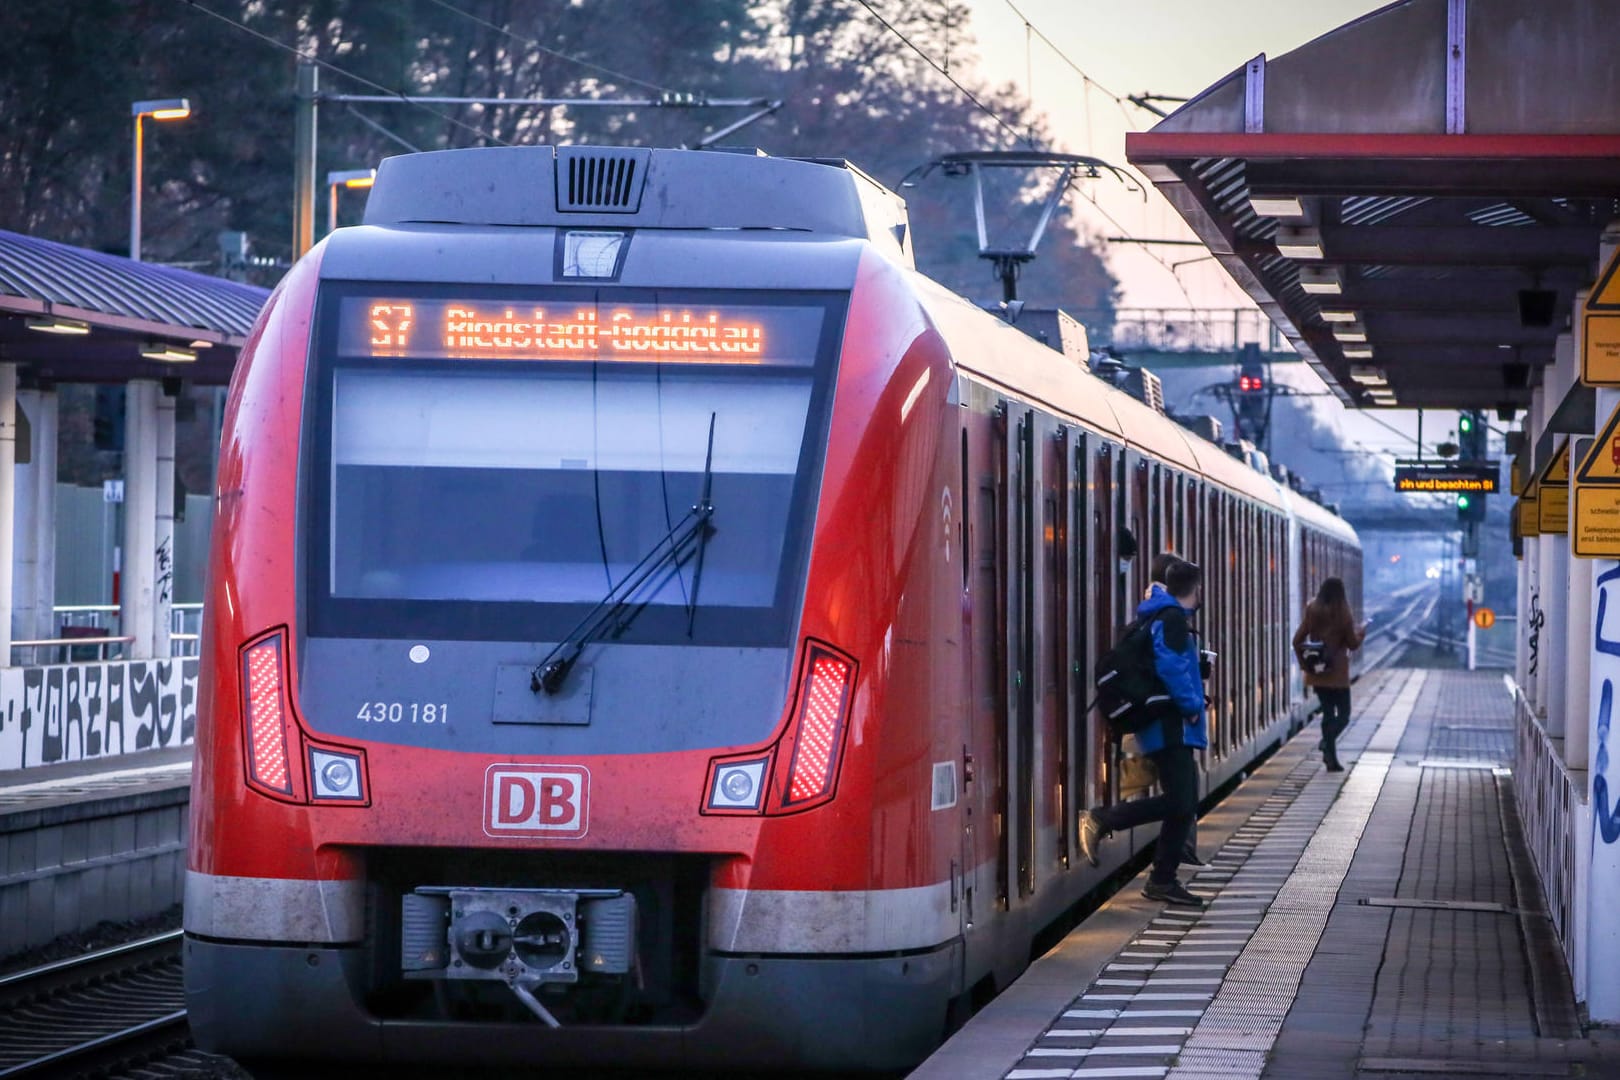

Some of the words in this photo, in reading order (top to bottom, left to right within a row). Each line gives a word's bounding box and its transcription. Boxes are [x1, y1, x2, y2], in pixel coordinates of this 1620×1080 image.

[371, 305, 413, 346] S7
[20, 662, 125, 769] FORZA
[356, 702, 403, 723] 430
[410, 703, 449, 724] 181
[497, 776, 576, 825] DB
